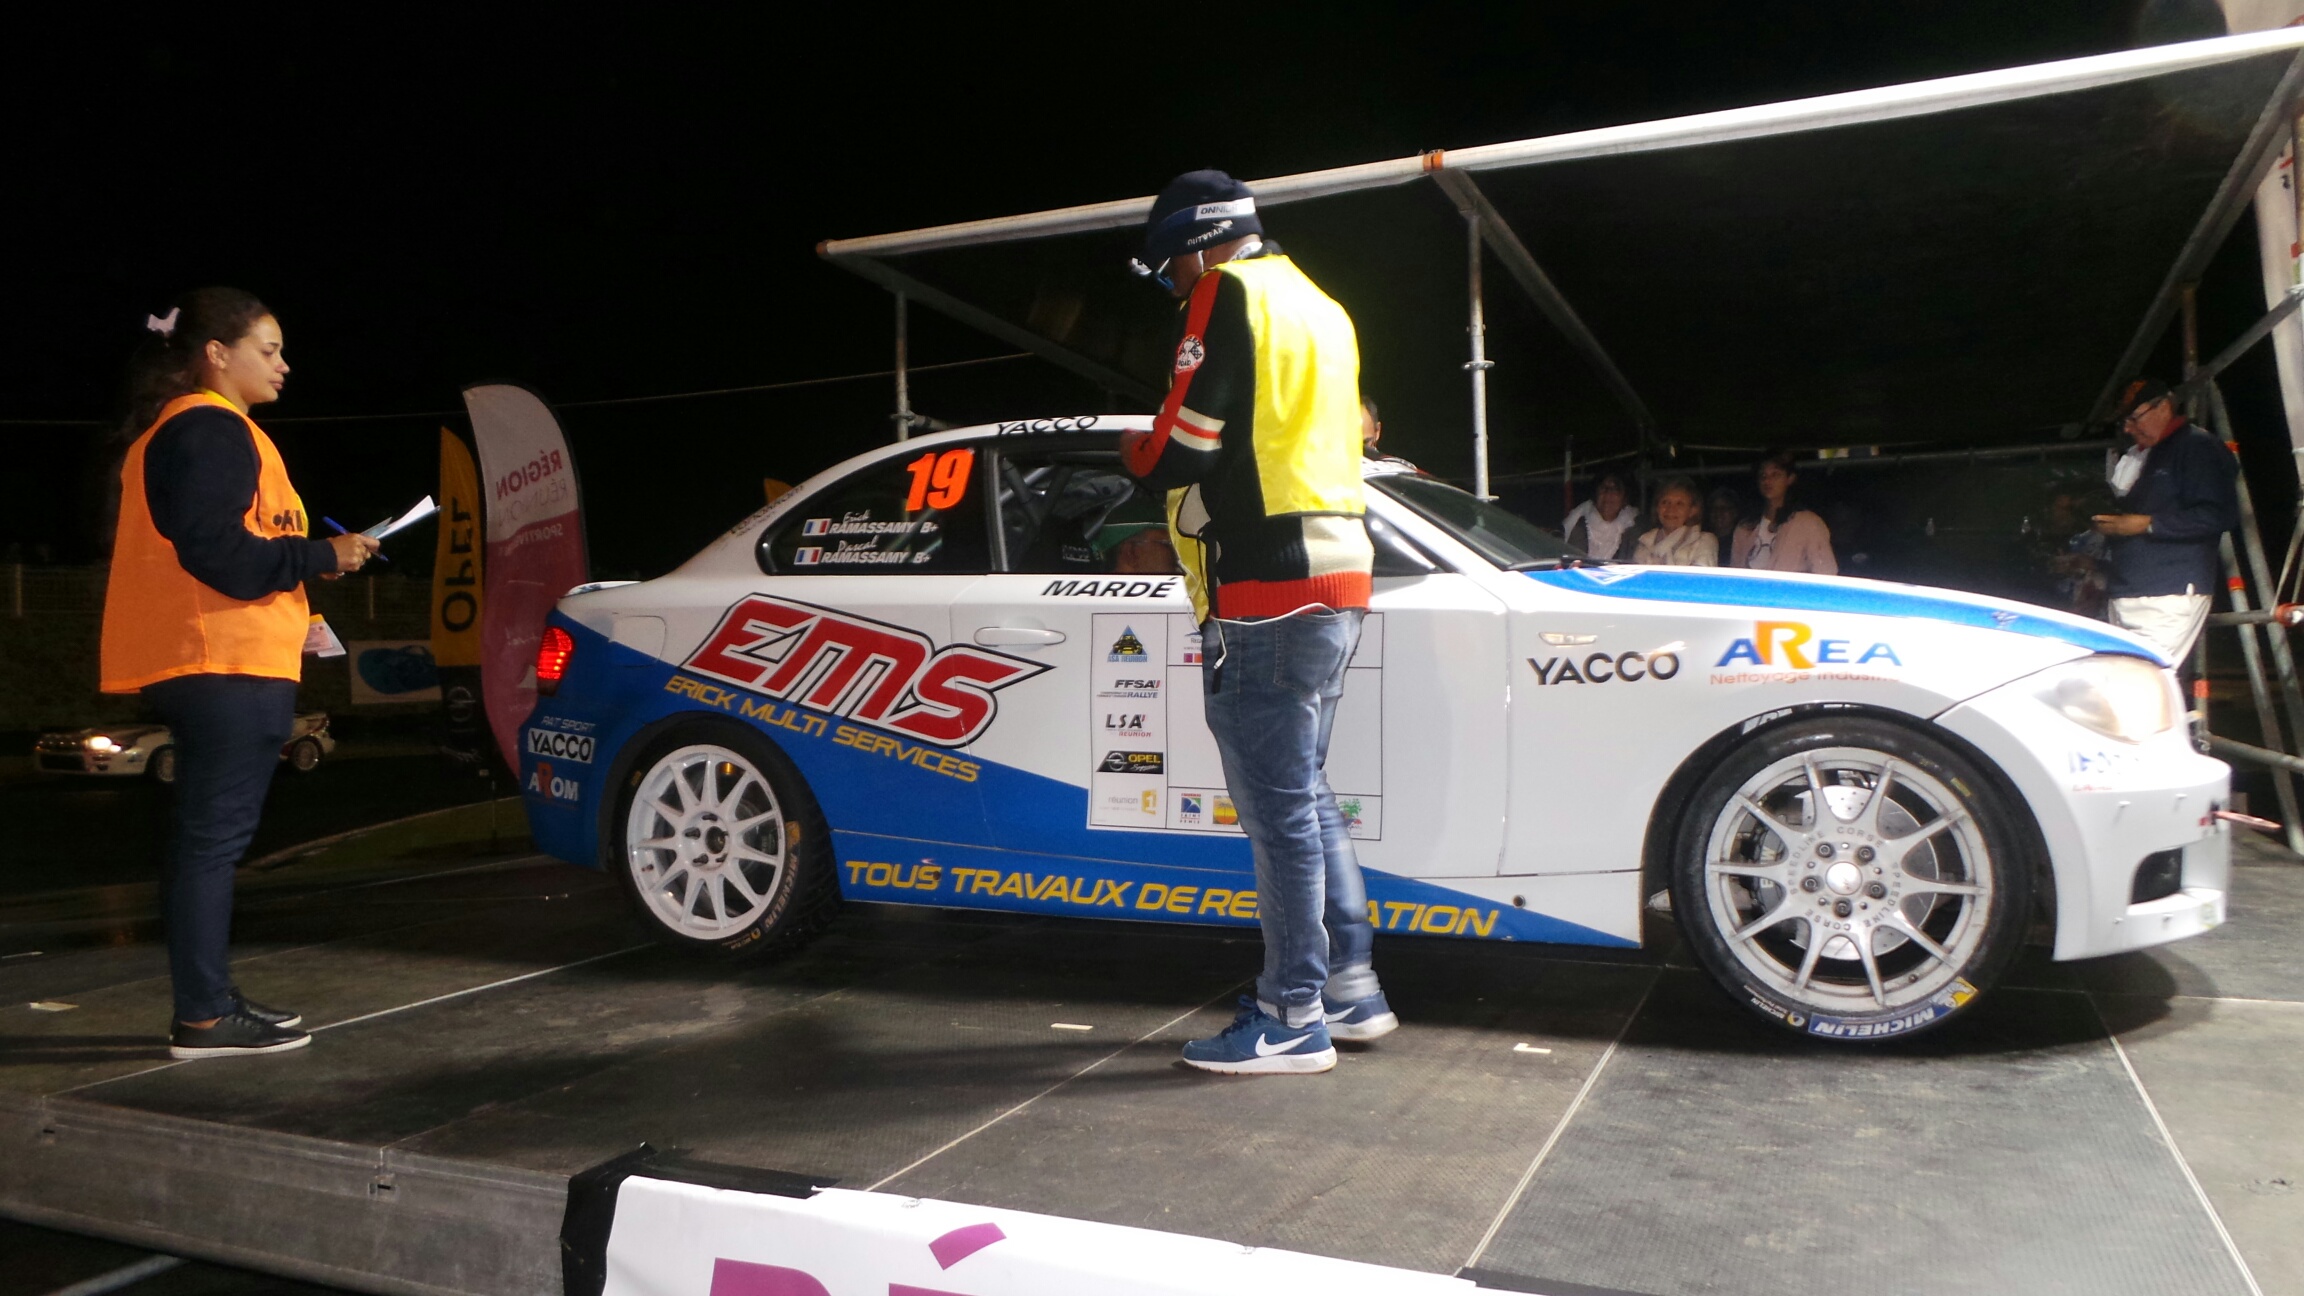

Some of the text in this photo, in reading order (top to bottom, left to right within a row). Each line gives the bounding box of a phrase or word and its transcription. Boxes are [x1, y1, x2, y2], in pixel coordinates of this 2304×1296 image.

[997, 415, 1098, 435] YACCO
[905, 449, 975, 512] 19
[829, 521, 939, 534] RAMASSAMY B+
[843, 509, 871, 524] Erick
[836, 535, 880, 553] Pascal
[820, 551, 932, 564] RAMASSAMY B+
[1042, 577, 1178, 598] MARDÉ
[1714, 620, 1902, 669] AREA
[687, 597, 1035, 742] EMS
[1527, 650, 1681, 686] YACCO
[1710, 671, 1809, 686] Nettoyage
[1114, 680, 1160, 688] FFSA
[664, 675, 983, 783] ERICK MULTI SERVICES
[531, 731, 592, 761] YACCO
[1128, 754, 1161, 764] OPEL
[527, 762, 579, 801] AROM
[845, 861, 942, 891] TOUS
[950, 867, 1132, 908] TRAVAUX
[1135, 883, 1200, 914] DE
[1815, 1007, 1935, 1036] MICHELIN
